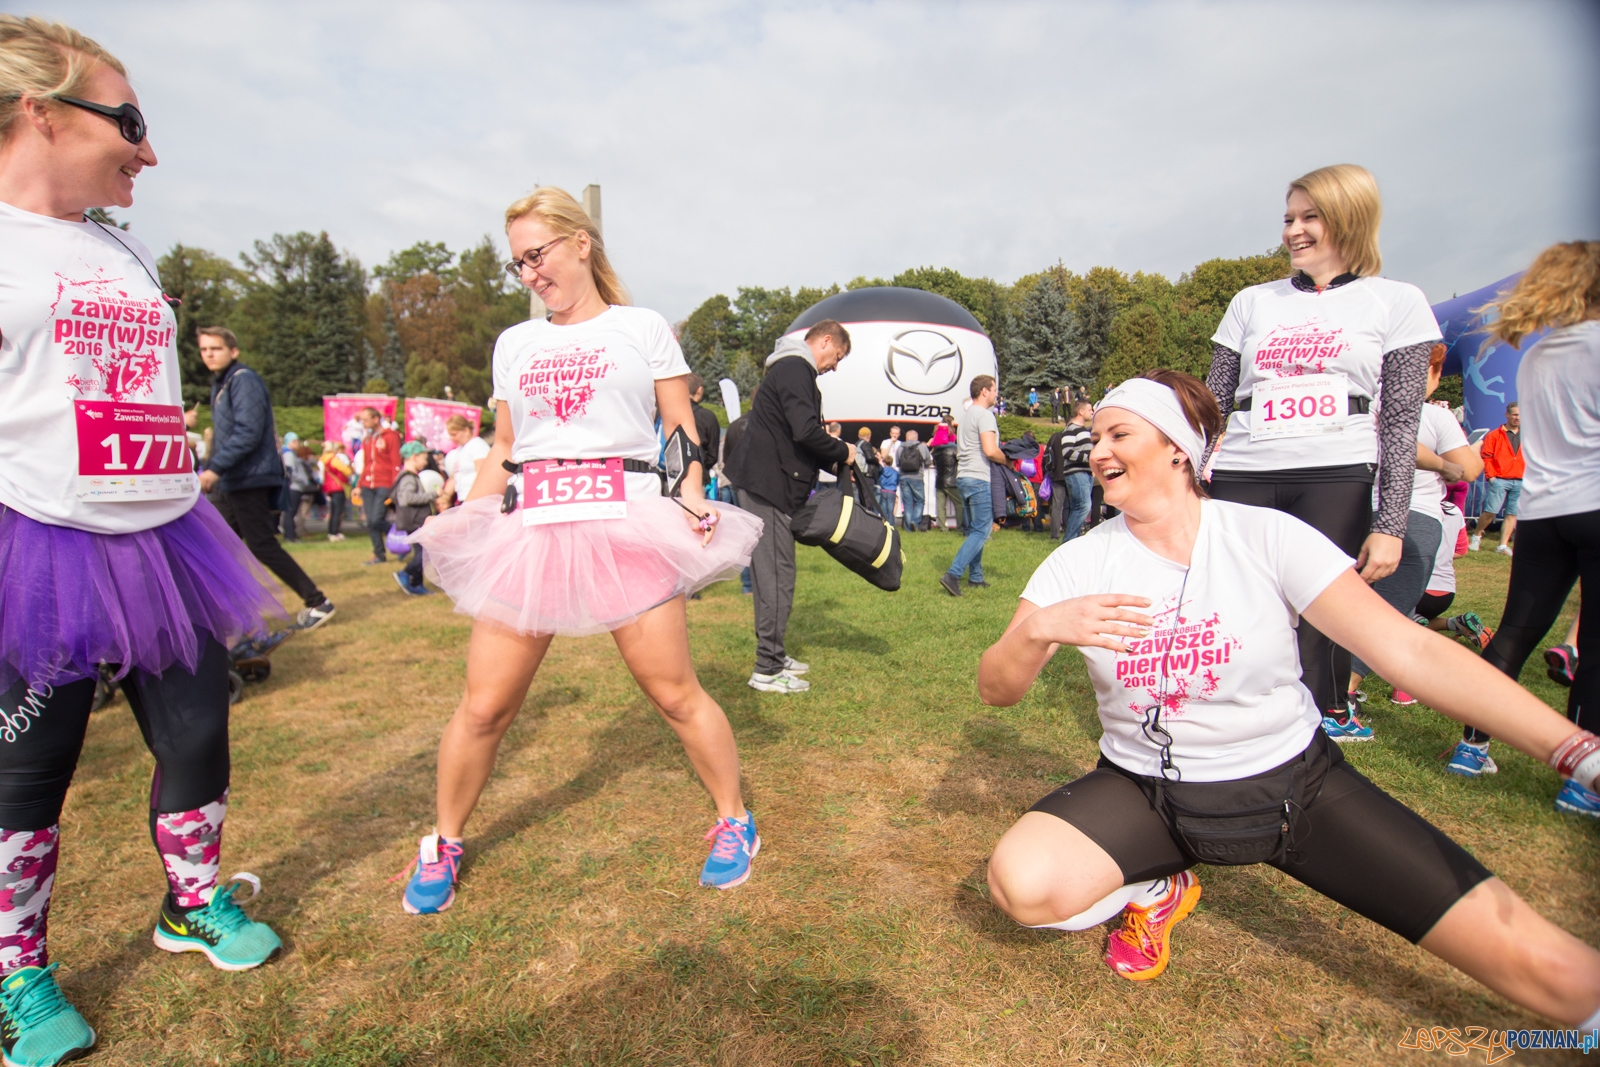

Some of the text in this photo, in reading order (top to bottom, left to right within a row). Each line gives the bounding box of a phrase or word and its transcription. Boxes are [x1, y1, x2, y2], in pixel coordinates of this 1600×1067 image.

[99, 296, 148, 309] BIEG KOBIET
[71, 299, 161, 326] zawsze
[64, 340, 103, 356] 2016
[1268, 334, 1335, 347] zawsze
[530, 354, 599, 370] zawsze
[1258, 360, 1282, 370] 2016
[524, 384, 550, 397] 2016
[1263, 394, 1336, 422] 1308
[114, 412, 144, 422] Zawsze
[170, 416, 181, 424] 2016
[100, 434, 186, 470] 1777
[536, 475, 614, 504] 1525
[1154, 624, 1203, 638] BIEG KOBIET
[1128, 630, 1215, 656] zawsze
[1124, 674, 1156, 688] 2016
